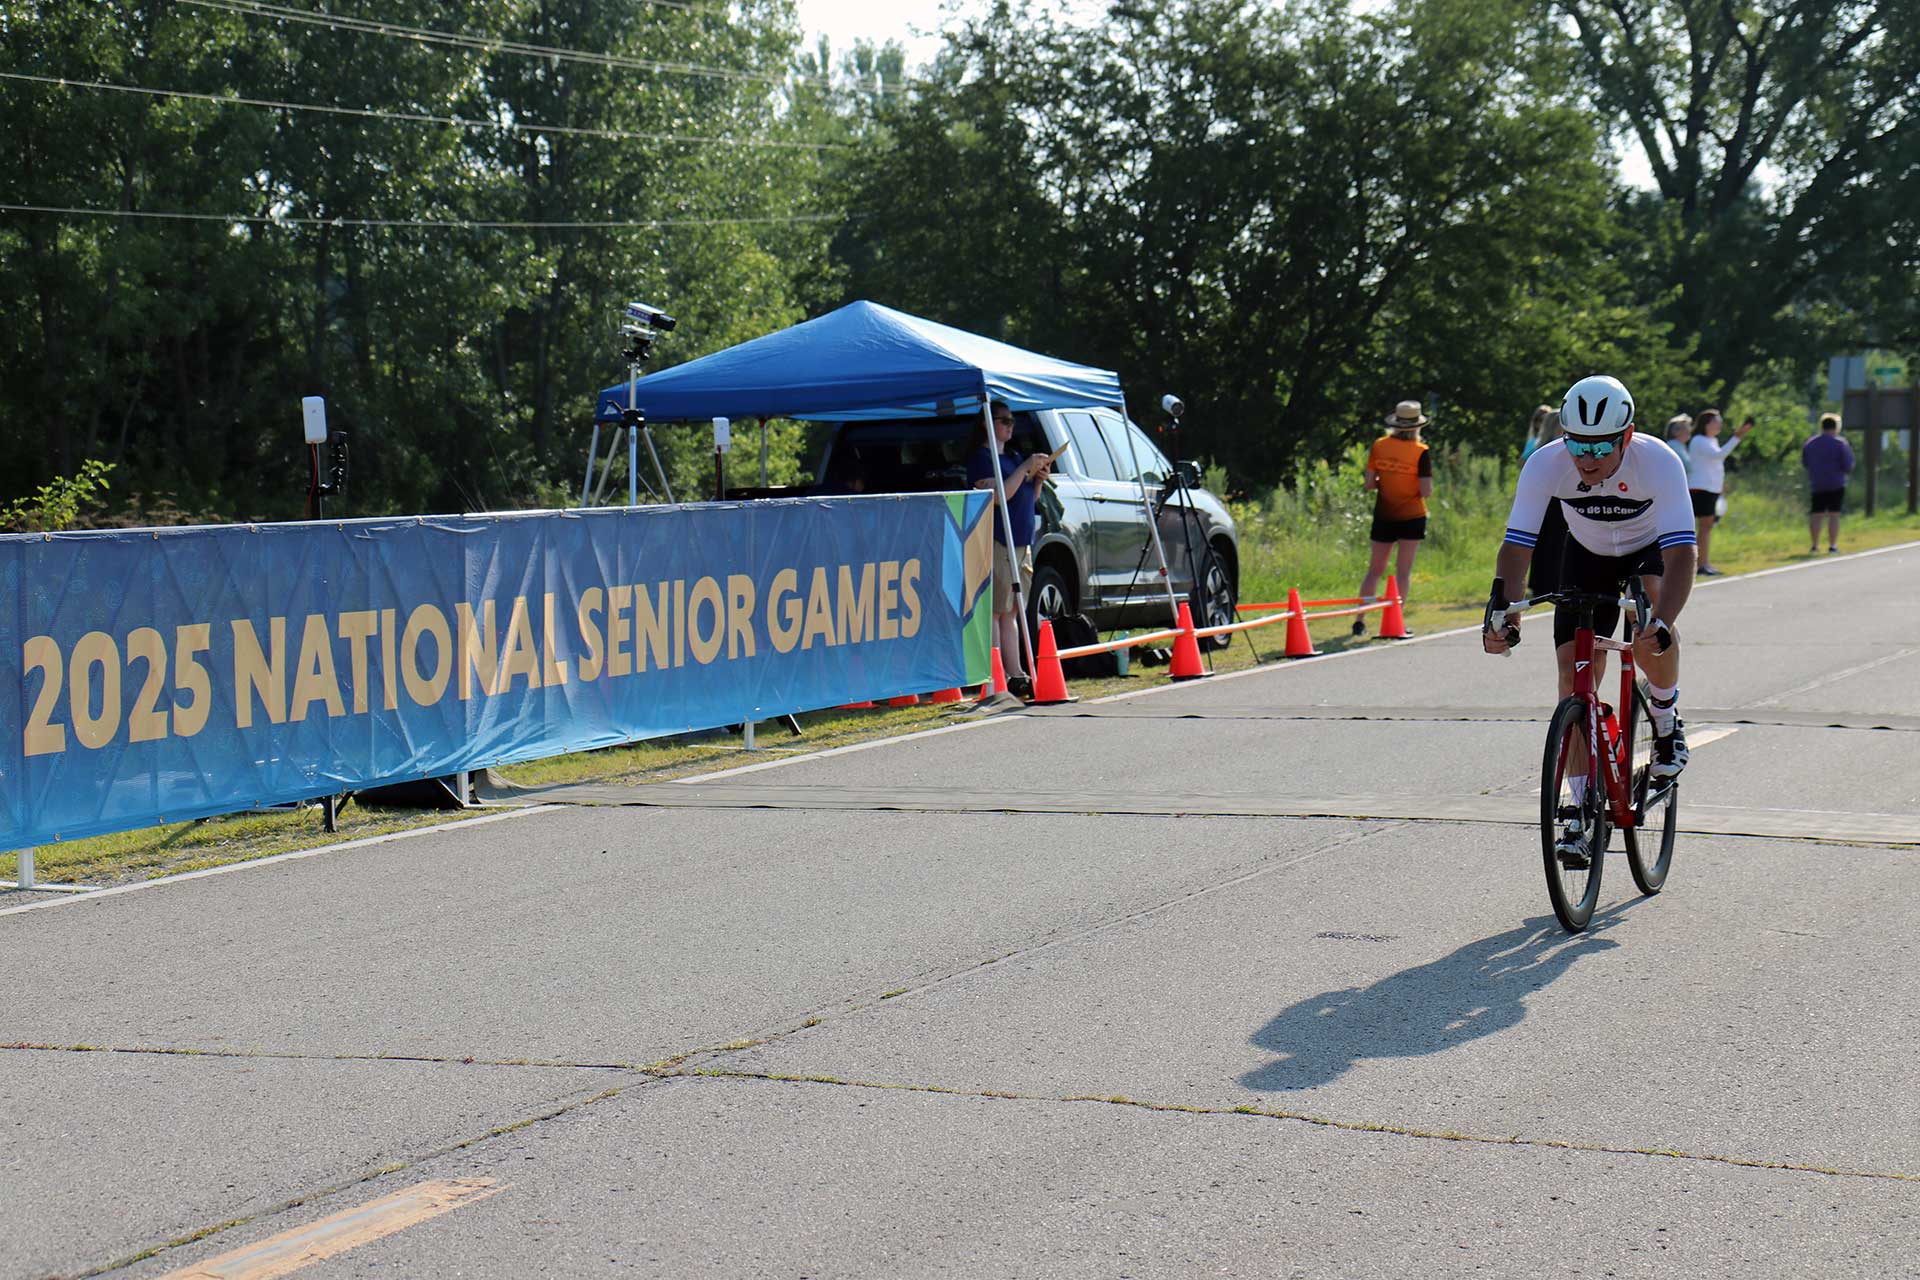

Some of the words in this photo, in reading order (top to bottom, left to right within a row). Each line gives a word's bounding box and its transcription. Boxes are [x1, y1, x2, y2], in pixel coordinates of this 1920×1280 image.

[1586, 505, 1600, 514] de
[1602, 506, 1613, 514] la
[23, 622, 213, 757] 2025
[230, 593, 569, 729] NATIONAL
[579, 574, 756, 682] SENIOR
[767, 558, 922, 654] GAMES
